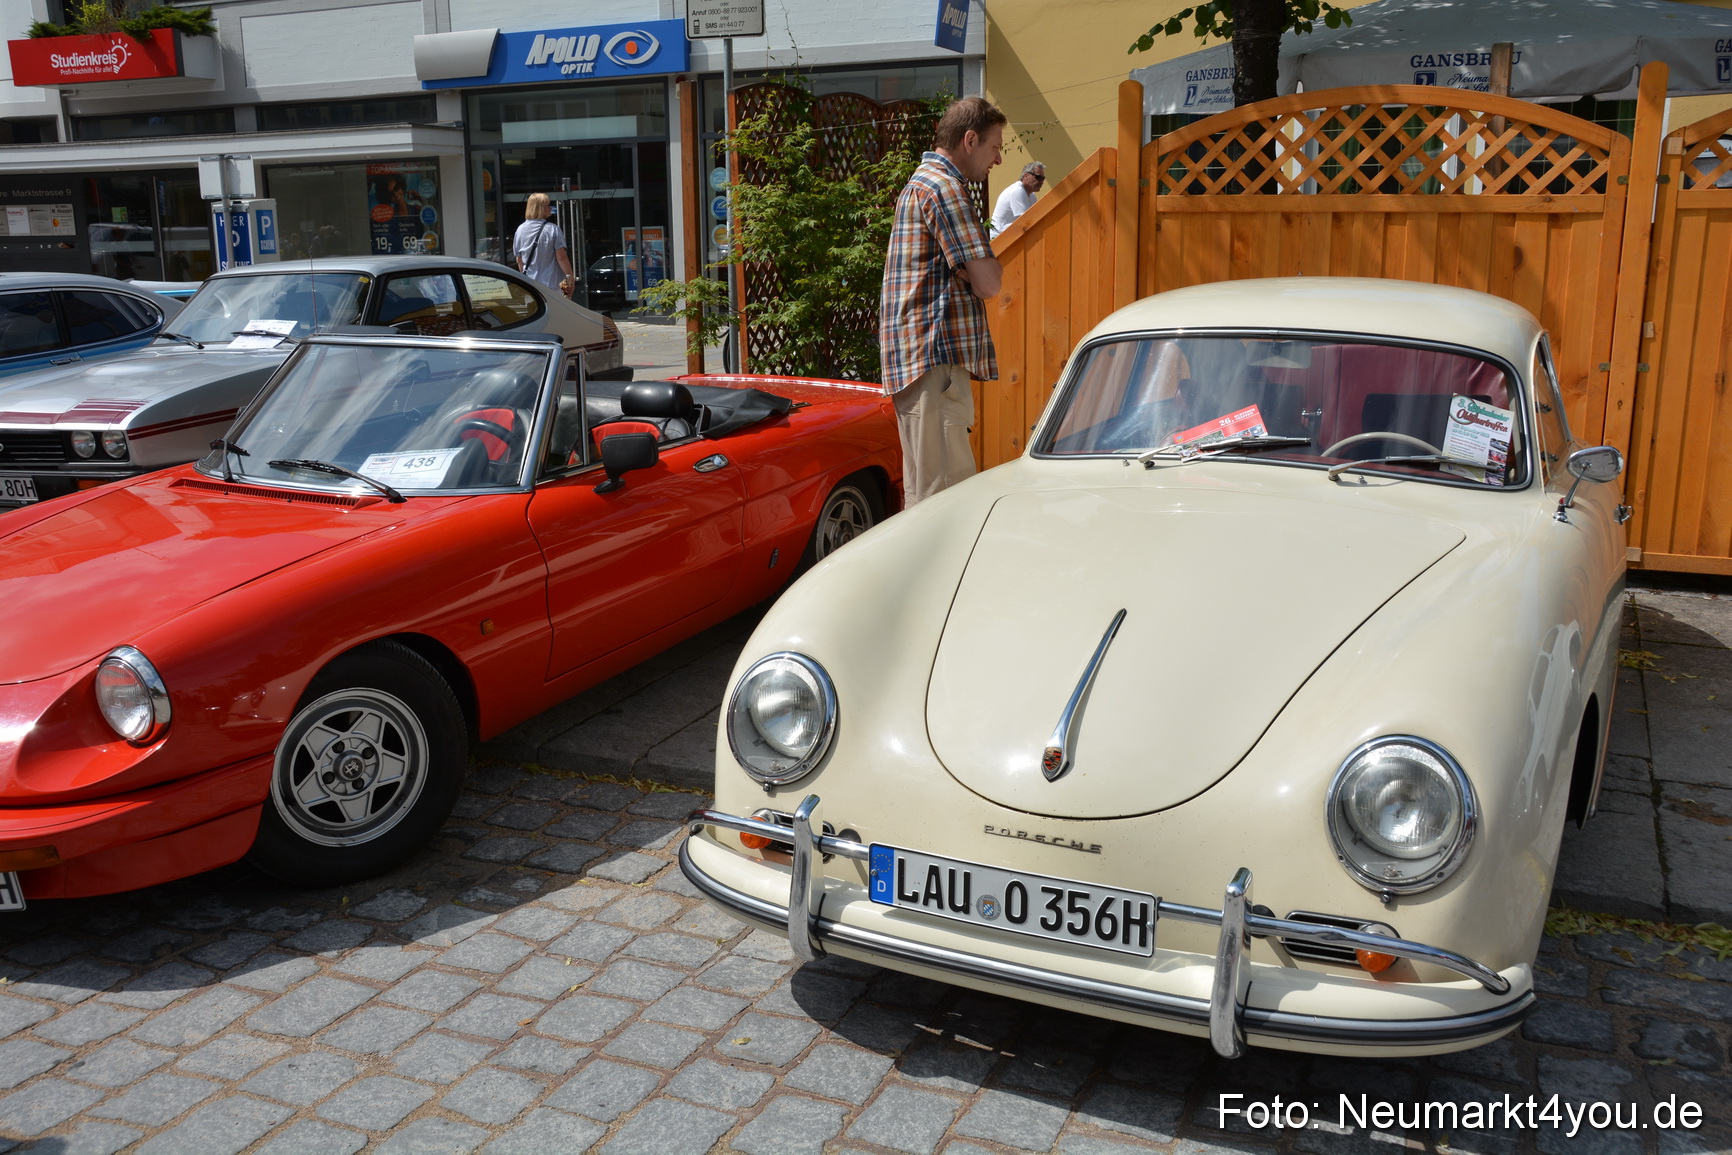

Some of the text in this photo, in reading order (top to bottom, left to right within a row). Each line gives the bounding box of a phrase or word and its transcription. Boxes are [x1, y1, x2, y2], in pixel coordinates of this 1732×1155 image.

[708, 7, 730, 15] 0800-88
[942, 2, 967, 29] APOLLO
[525, 34, 601, 66] APOLLO
[50, 50, 118, 69] Studienkreis
[1410, 51, 1522, 68] GANSBRU
[60, 66, 94, 76] Profi-Nachhilfe
[560, 62, 594, 76] OPTIK
[12, 189, 64, 198] Marktstrasse
[65, 188, 72, 196] 9
[220, 215, 245, 227] HER
[261, 215, 271, 236] P
[1457, 398, 1467, 409] 3.
[1219, 417, 1235, 427] 26.
[403, 456, 435, 470] 438
[984, 824, 1103, 853] PORSCHE
[877, 879, 887, 893] D
[897, 856, 971, 915] LAU
[1040, 885, 1149, 948] 356H
